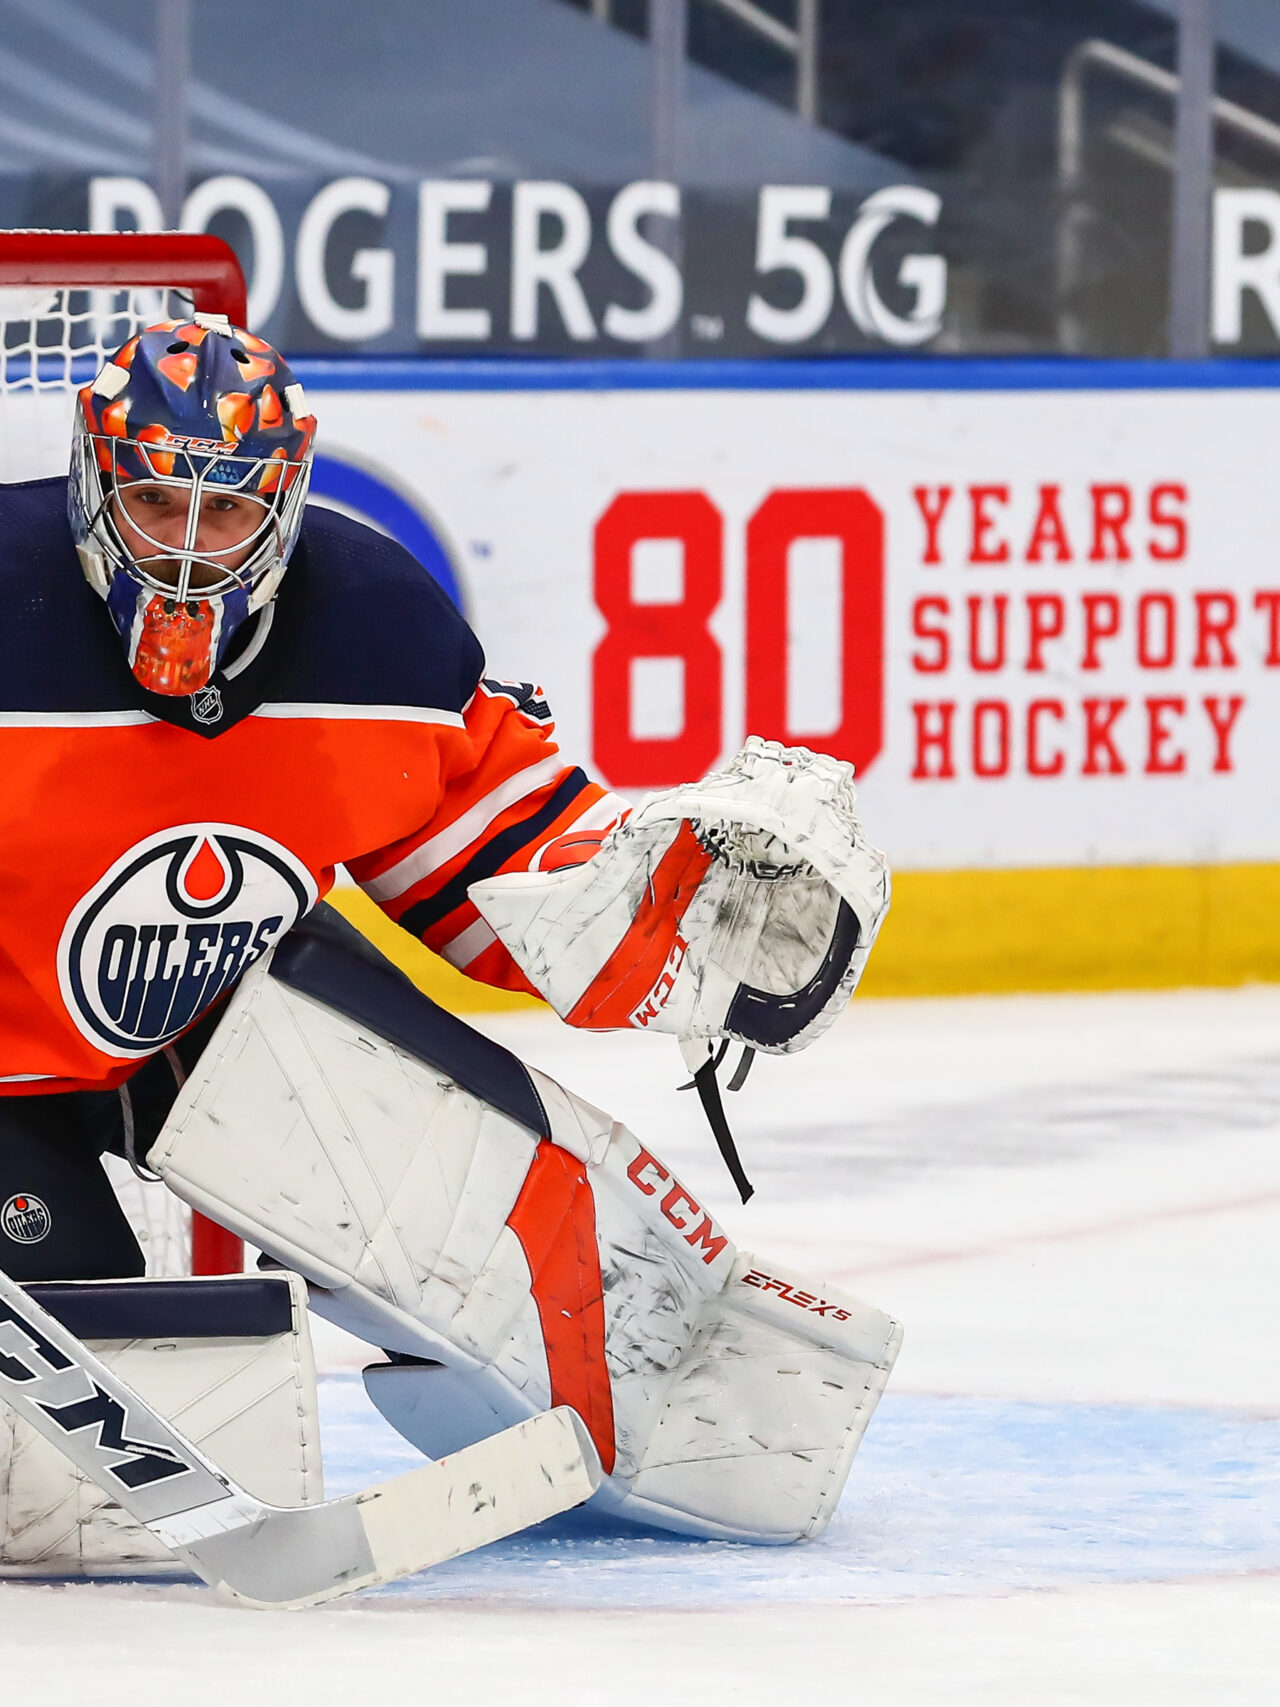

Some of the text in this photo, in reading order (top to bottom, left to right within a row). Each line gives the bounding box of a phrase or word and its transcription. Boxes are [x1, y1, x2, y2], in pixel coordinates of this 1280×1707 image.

[746, 185, 948, 345] 5G
[163, 434, 240, 455] CCM
[912, 482, 1188, 564] YEARS
[591, 486, 886, 788] 80
[198, 695, 216, 715] NHL
[911, 695, 1245, 780] HOCKEY
[634, 934, 690, 1027] CCM
[626, 1143, 729, 1265] CCM
